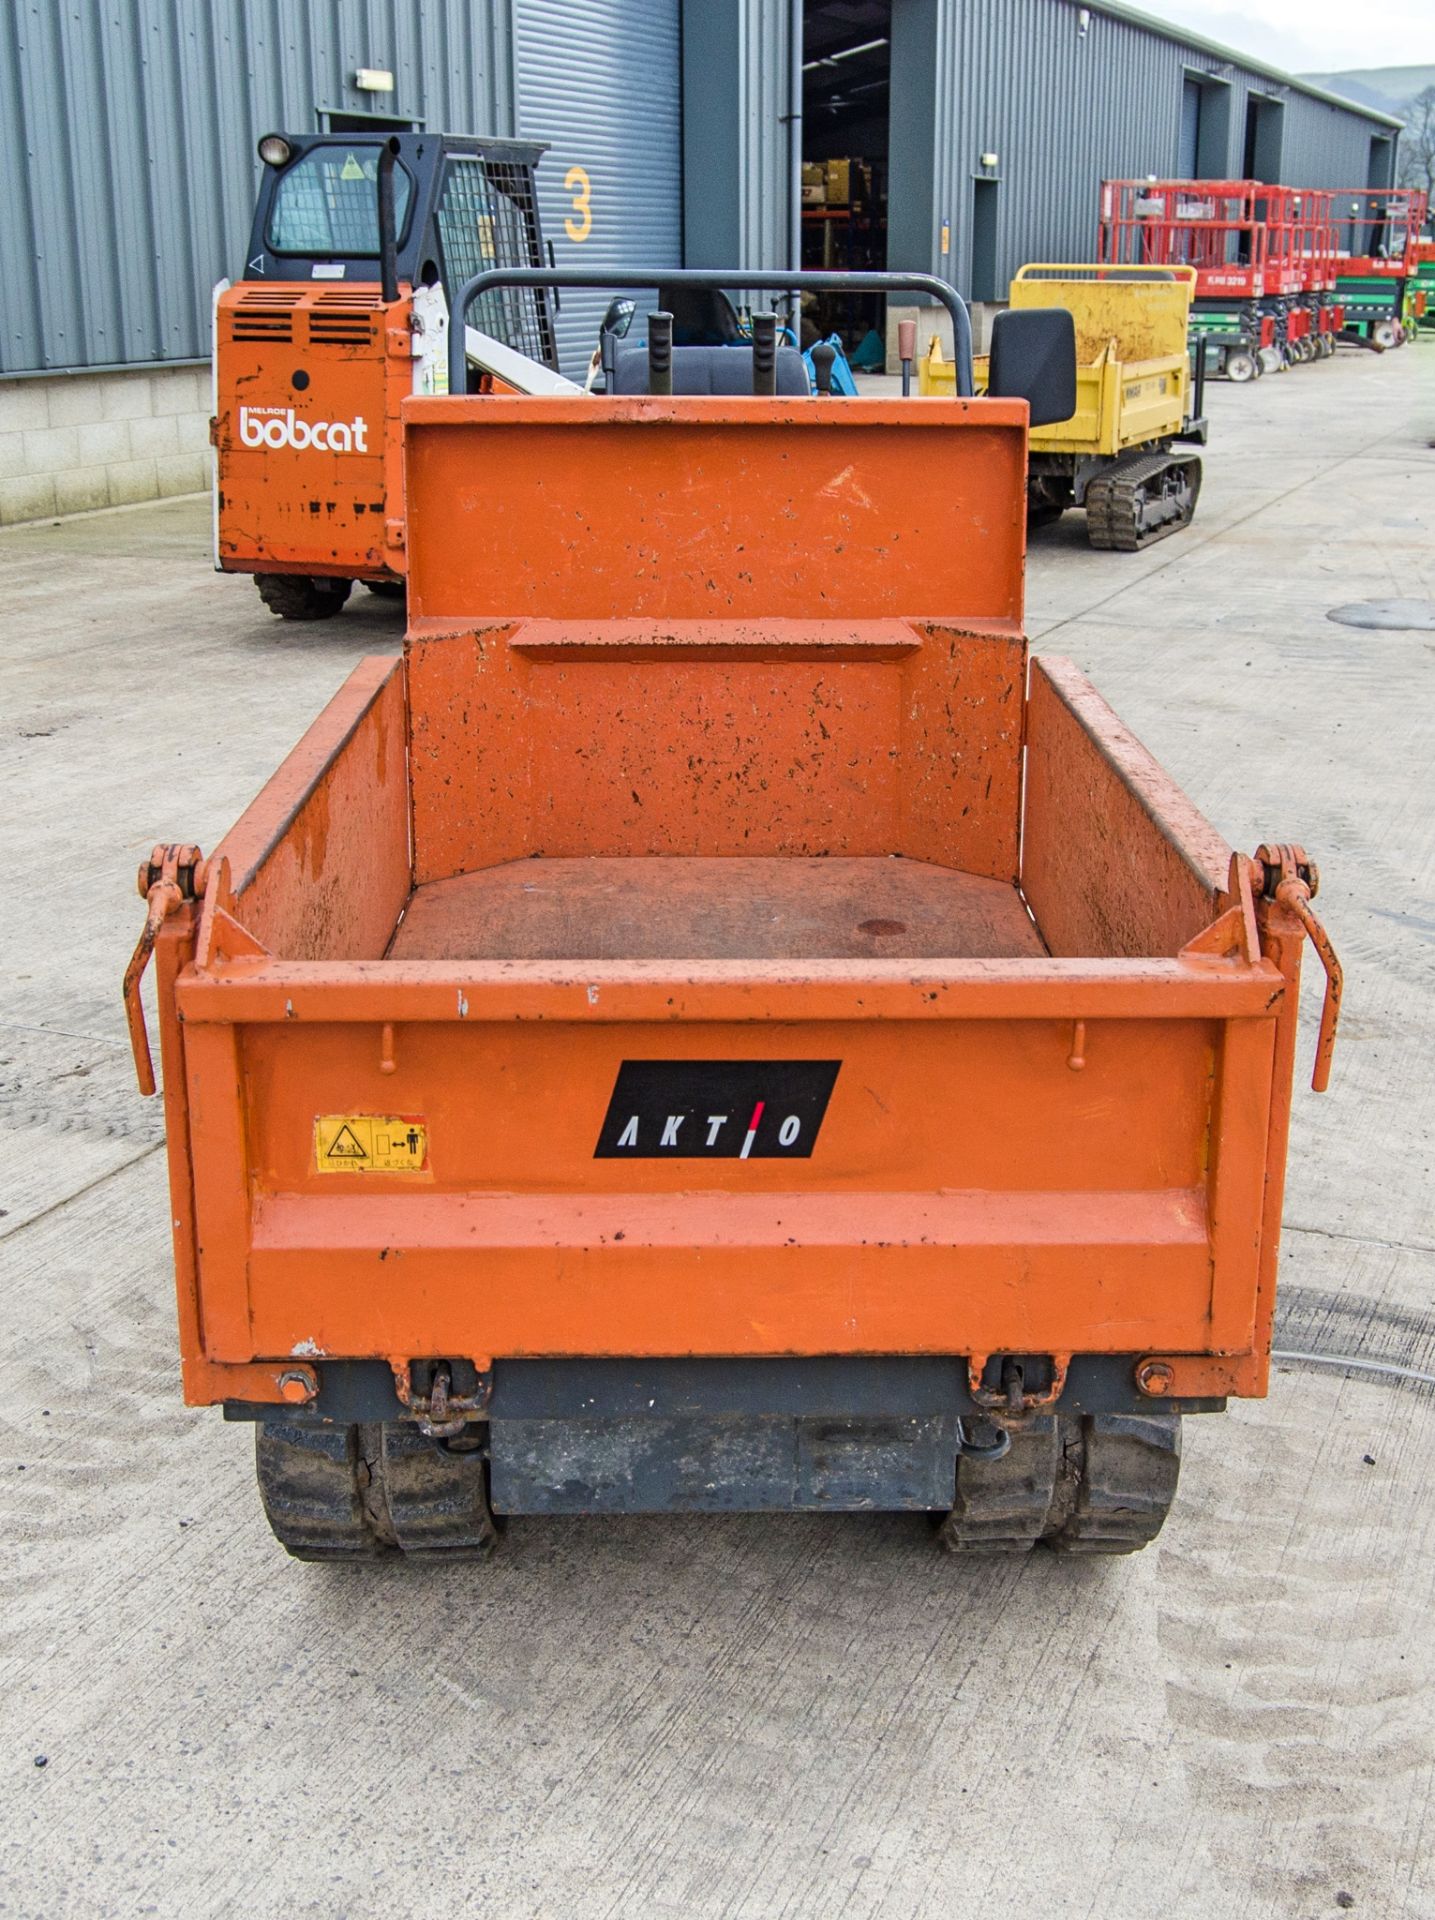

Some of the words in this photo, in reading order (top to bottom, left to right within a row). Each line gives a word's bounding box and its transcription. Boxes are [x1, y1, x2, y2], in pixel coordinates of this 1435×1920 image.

[564, 166, 592, 242] 3
[240, 406, 368, 453] bobcat
[248, 407, 287, 416] MELROE
